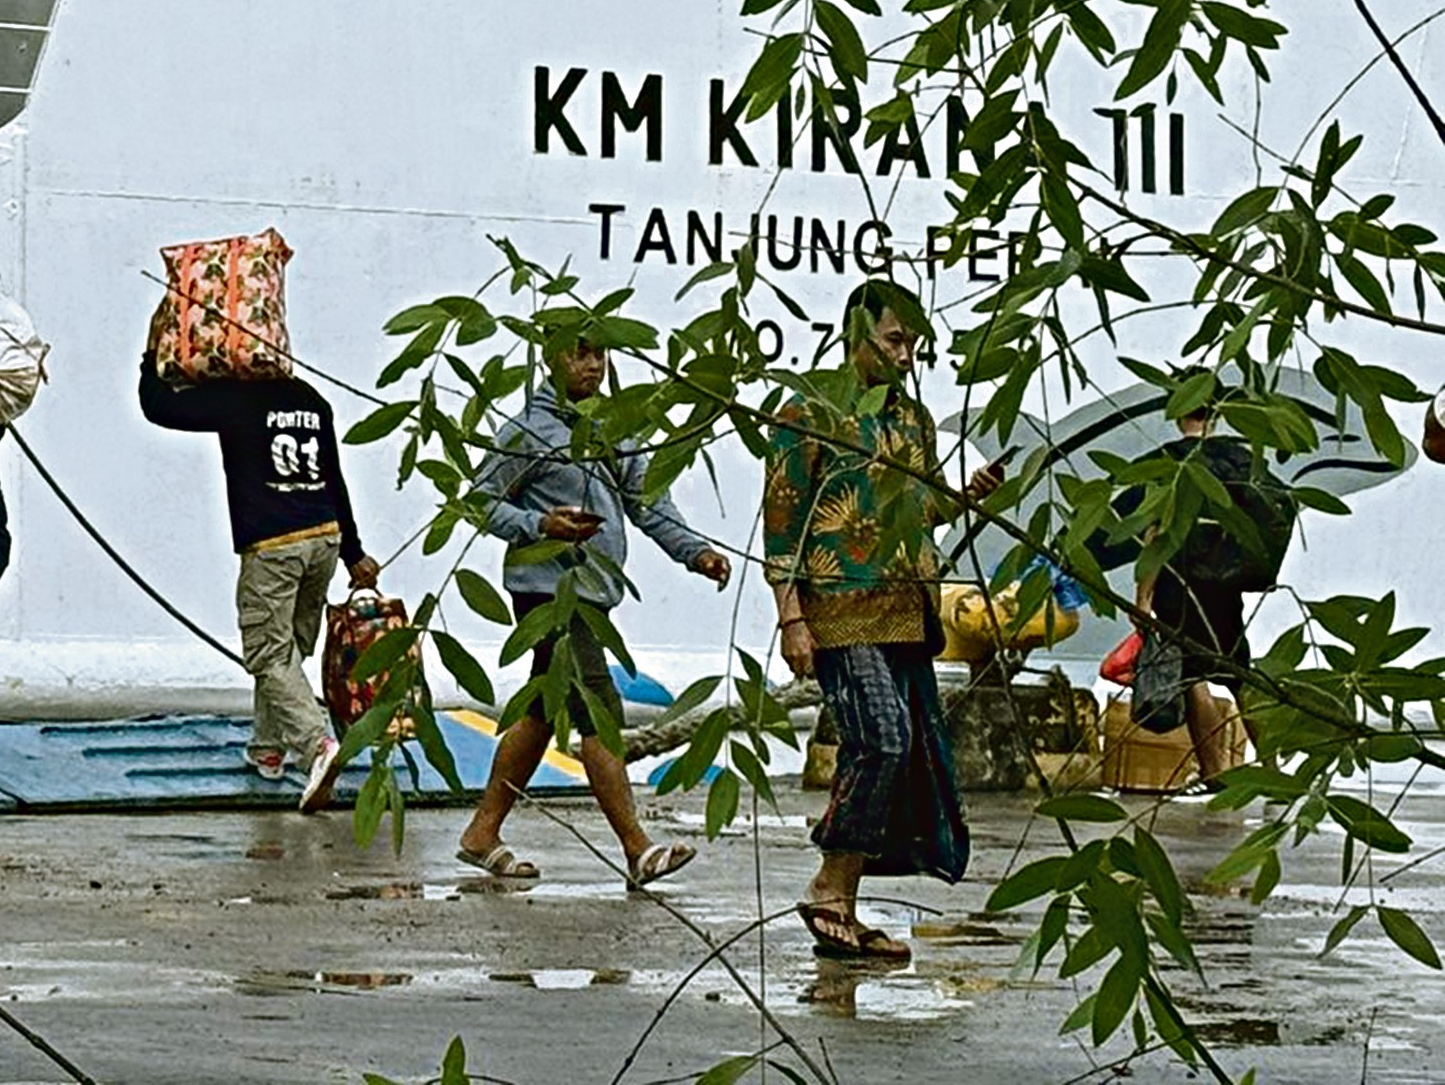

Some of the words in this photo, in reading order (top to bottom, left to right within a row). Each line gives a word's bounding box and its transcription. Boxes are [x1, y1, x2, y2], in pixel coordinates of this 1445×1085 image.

[533, 66, 663, 161] KM
[709, 78, 1067, 186] KIRAN
[1113, 109, 1184, 195] III
[589, 203, 894, 275] TANJUNG
[266, 409, 321, 431] PORTER
